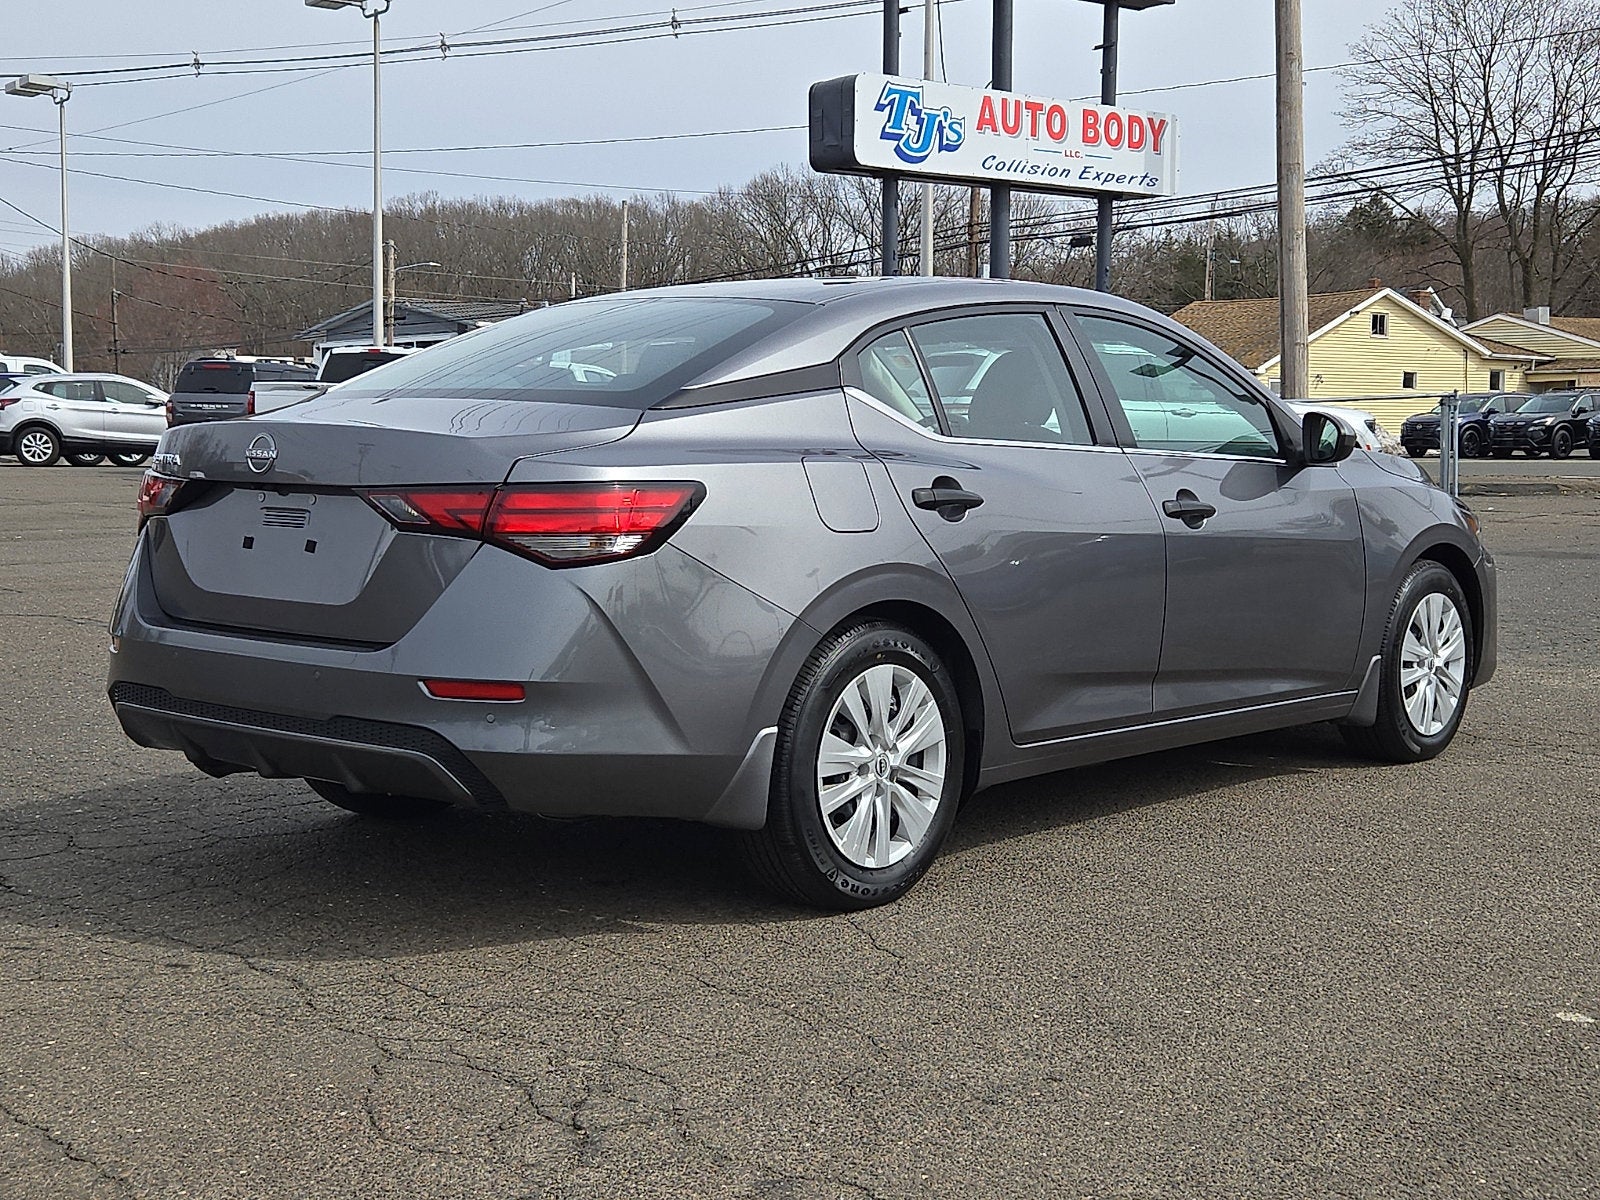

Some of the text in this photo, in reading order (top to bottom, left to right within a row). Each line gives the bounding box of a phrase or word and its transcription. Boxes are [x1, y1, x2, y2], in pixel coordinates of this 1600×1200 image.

[875, 82, 1167, 162] TJ's AUTO BODY
[1064, 149, 1083, 160] LLC.
[981, 155, 1159, 188] Collision Experts
[153, 453, 181, 466] ENTRA
[245, 448, 277, 459] NISSAN
